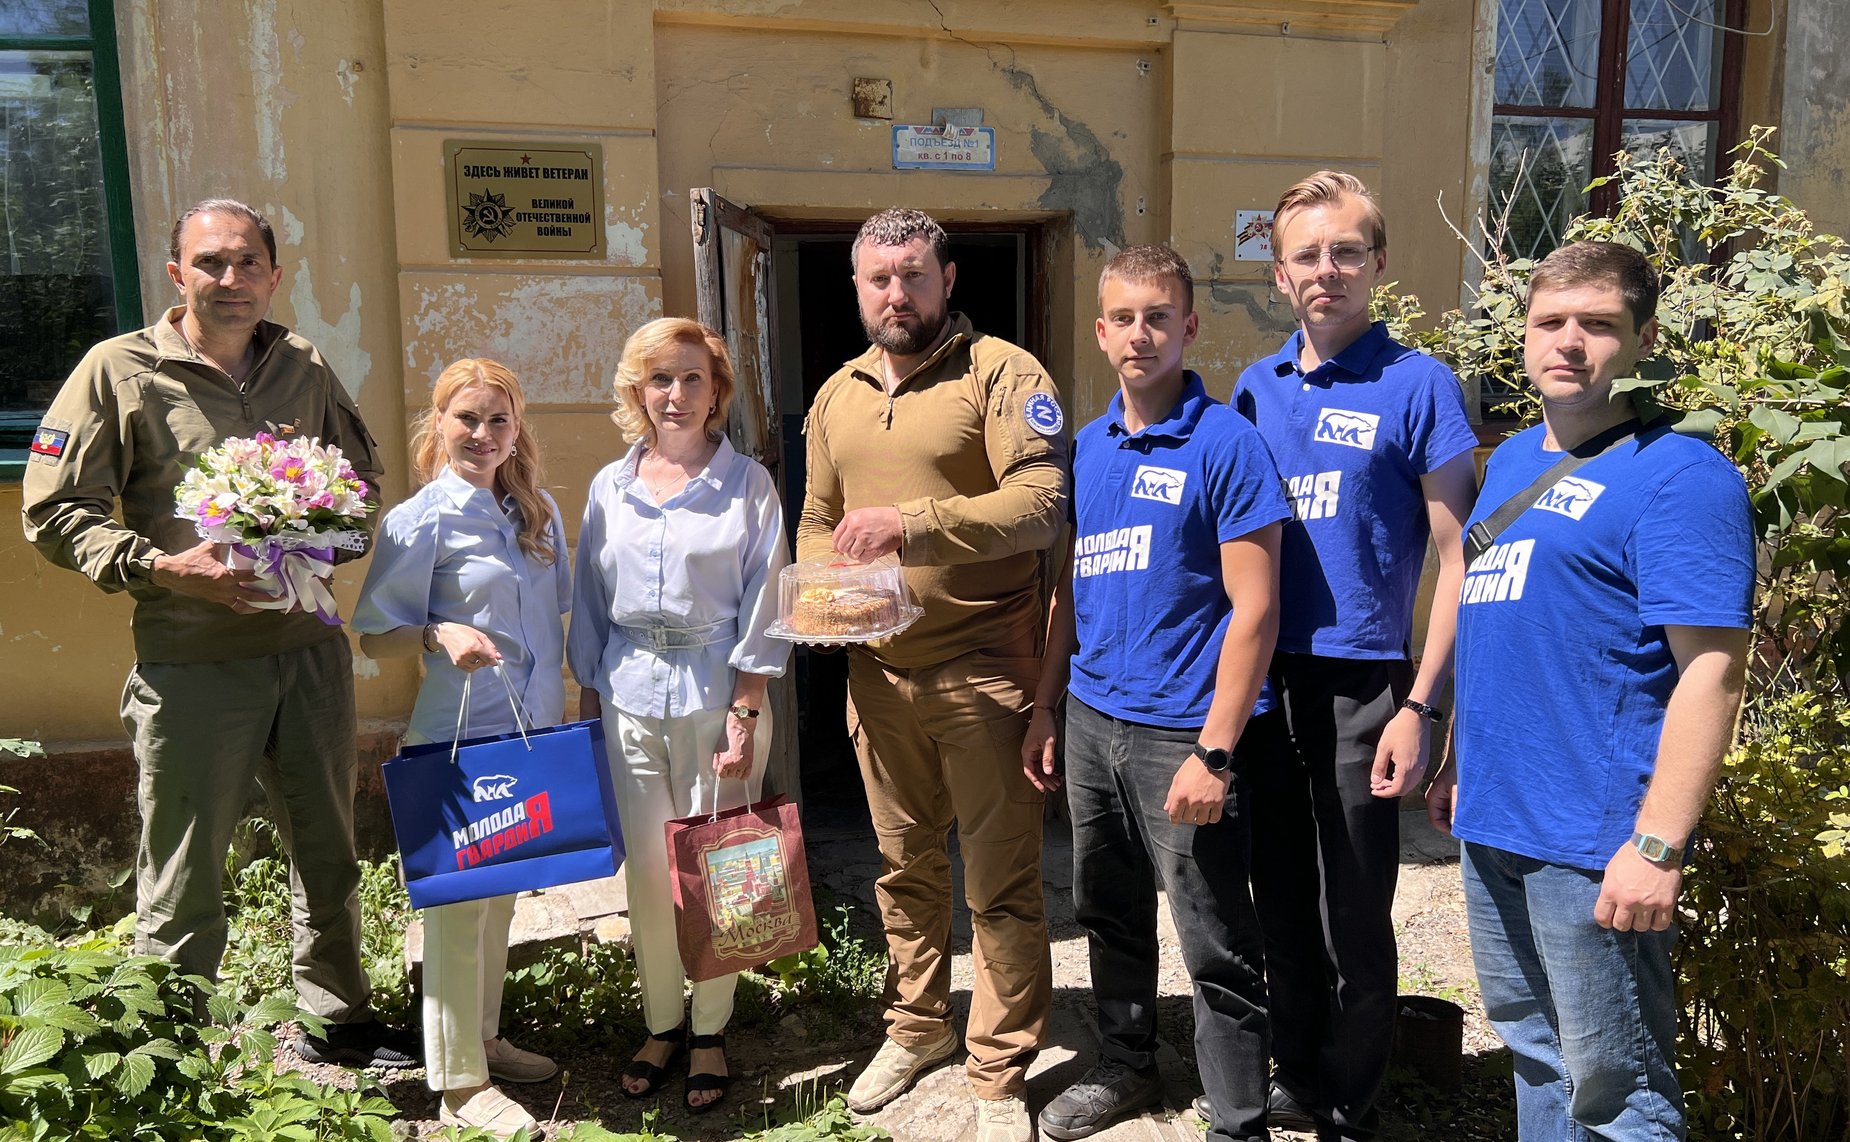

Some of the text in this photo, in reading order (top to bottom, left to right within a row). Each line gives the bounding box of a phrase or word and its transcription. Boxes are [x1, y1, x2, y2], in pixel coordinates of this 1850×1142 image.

[910, 137, 979, 149] ПОДЪЕЗД №1
[918, 152, 932, 160] кв.
[943, 151, 948, 160] 1
[951, 153, 964, 161] по
[965, 152, 972, 161] 8
[464, 165, 589, 180] ЗДЕСЬ ЖИВЕТ ВЕТЕРАН
[531, 198, 575, 210] ВЕЛИКОЙ
[516, 212, 591, 224] ОТЕЧЕСТВЕННОЙ
[537, 225, 572, 237] ВОЙНЫ
[718, 914, 793, 947] Москва
